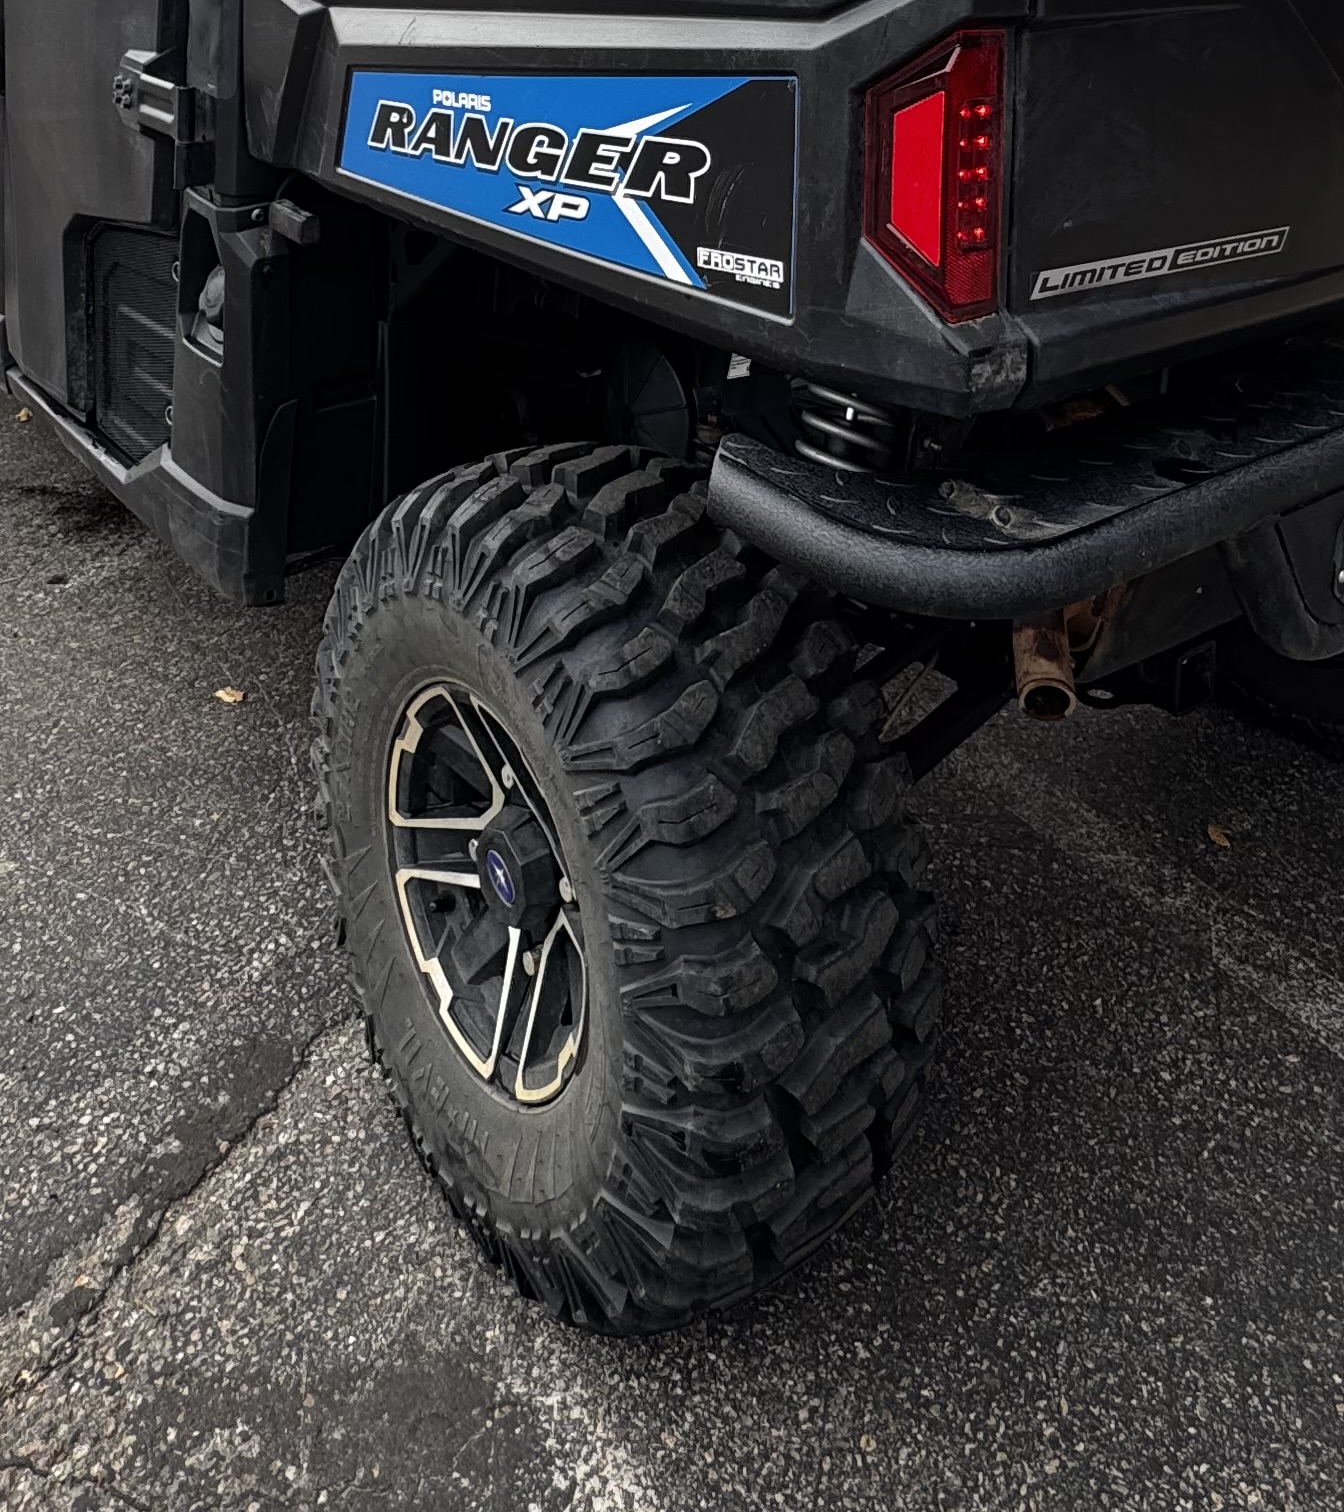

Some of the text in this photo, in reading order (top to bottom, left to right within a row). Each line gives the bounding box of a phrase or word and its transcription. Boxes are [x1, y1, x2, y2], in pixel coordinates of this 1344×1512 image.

[432, 89, 491, 112] POLARIS
[367, 99, 712, 205] RANGER
[507, 185, 590, 221] XP
[1038, 234, 1280, 294] LIMITED EDITION
